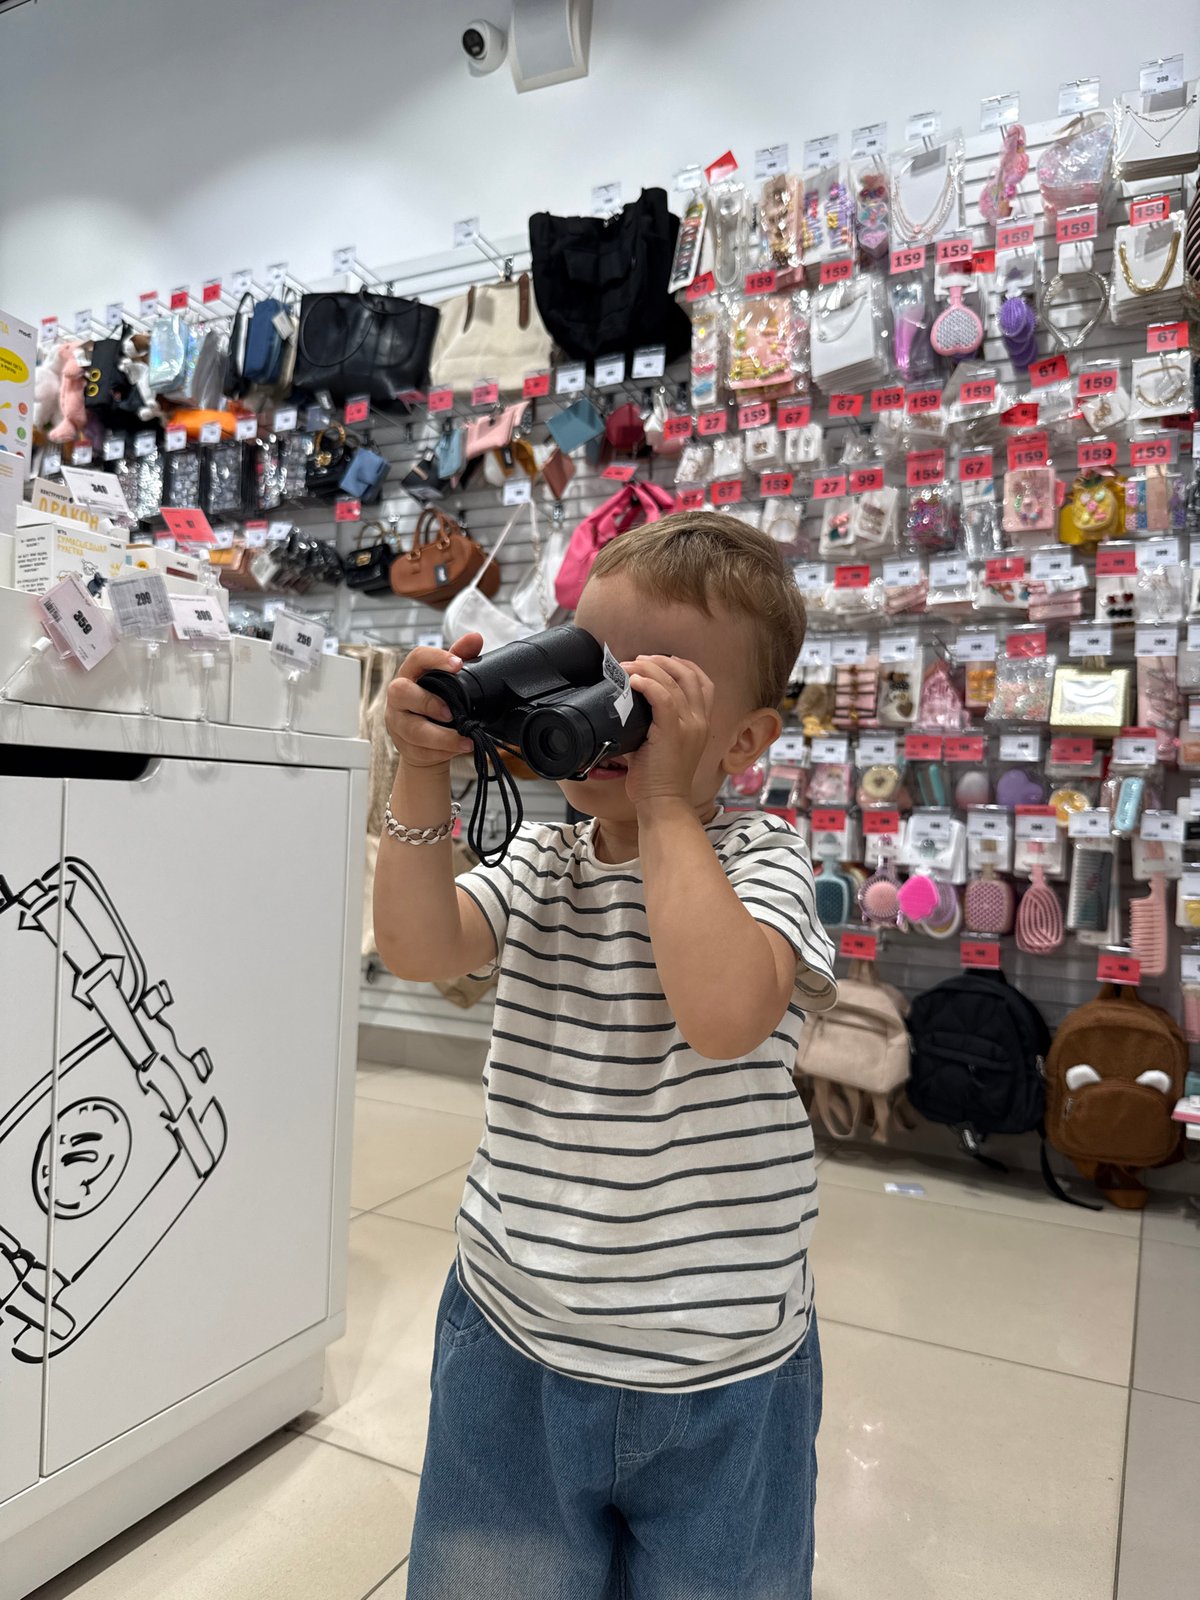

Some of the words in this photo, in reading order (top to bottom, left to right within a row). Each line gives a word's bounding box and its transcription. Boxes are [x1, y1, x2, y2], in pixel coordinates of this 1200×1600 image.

[1134, 203, 1165, 217] 159
[1061, 222, 1090, 236] 159
[1002, 230, 1030, 244] 159
[941, 245, 969, 258] 159
[894, 252, 921, 267] 159
[825, 266, 849, 279] 159
[749, 275, 773, 288] 159
[1157, 330, 1179, 343] 67
[1038, 363, 1057, 377] 67
[1083, 376, 1113, 389] 159
[964, 384, 991, 398] 159
[836, 398, 855, 411] 67
[874, 392, 901, 406] 159
[911, 394, 938, 408] 159
[704, 417, 721, 429] 27
[742, 410, 767, 423] 159
[784, 411, 802, 424] 67
[1014, 450, 1043, 464] 159
[1082, 447, 1112, 460] 159
[1135, 445, 1167, 459] 159
[913, 468, 940, 481] 159
[965, 462, 984, 475] 67
[765, 478, 789, 490] 159
[857, 472, 876, 486] 99
[717, 485, 734, 498] 67
[822, 480, 839, 493] 27
[135, 591, 152, 606] 299
[73, 610, 93, 635] 359
